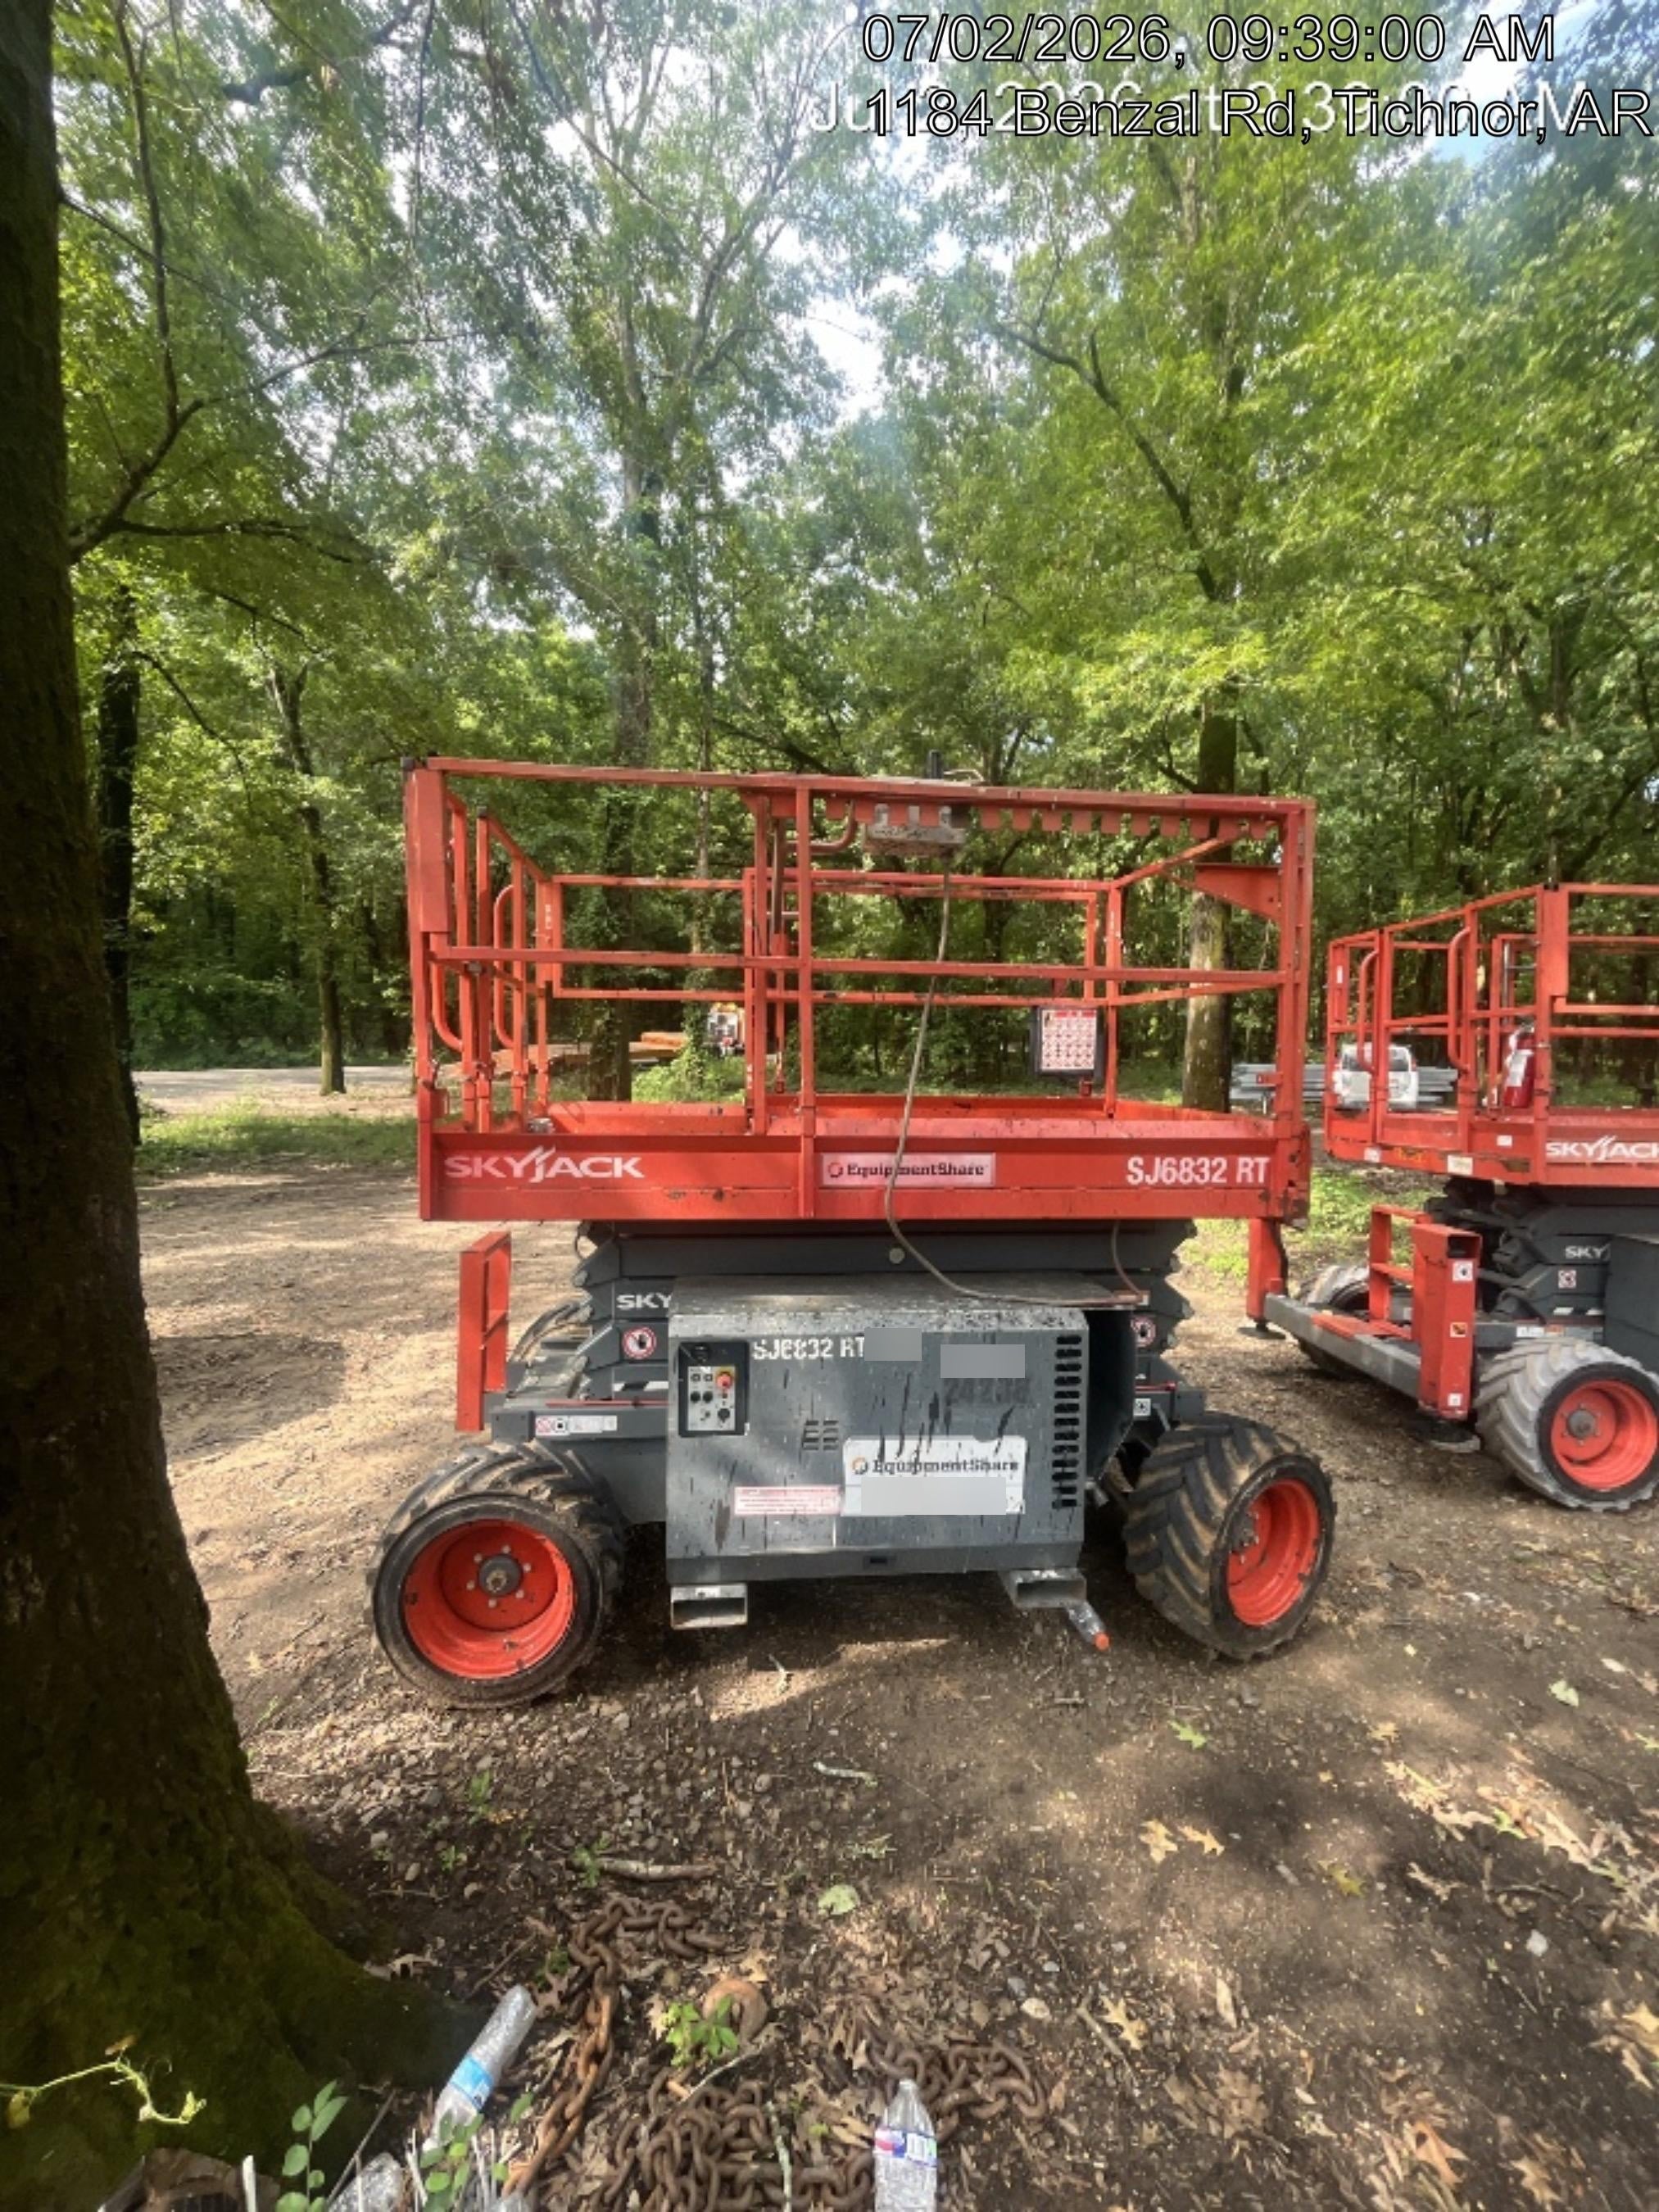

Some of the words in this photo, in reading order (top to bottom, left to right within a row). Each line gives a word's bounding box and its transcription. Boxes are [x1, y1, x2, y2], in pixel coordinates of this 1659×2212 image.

[444, 1145, 646, 1184] SKYJACK
[1126, 1157, 1228, 1185] SJ6832
[1236, 1157, 1271, 1185] RT
[753, 1336, 834, 1361] SJ6832
[840, 1336, 865, 1358] RT
